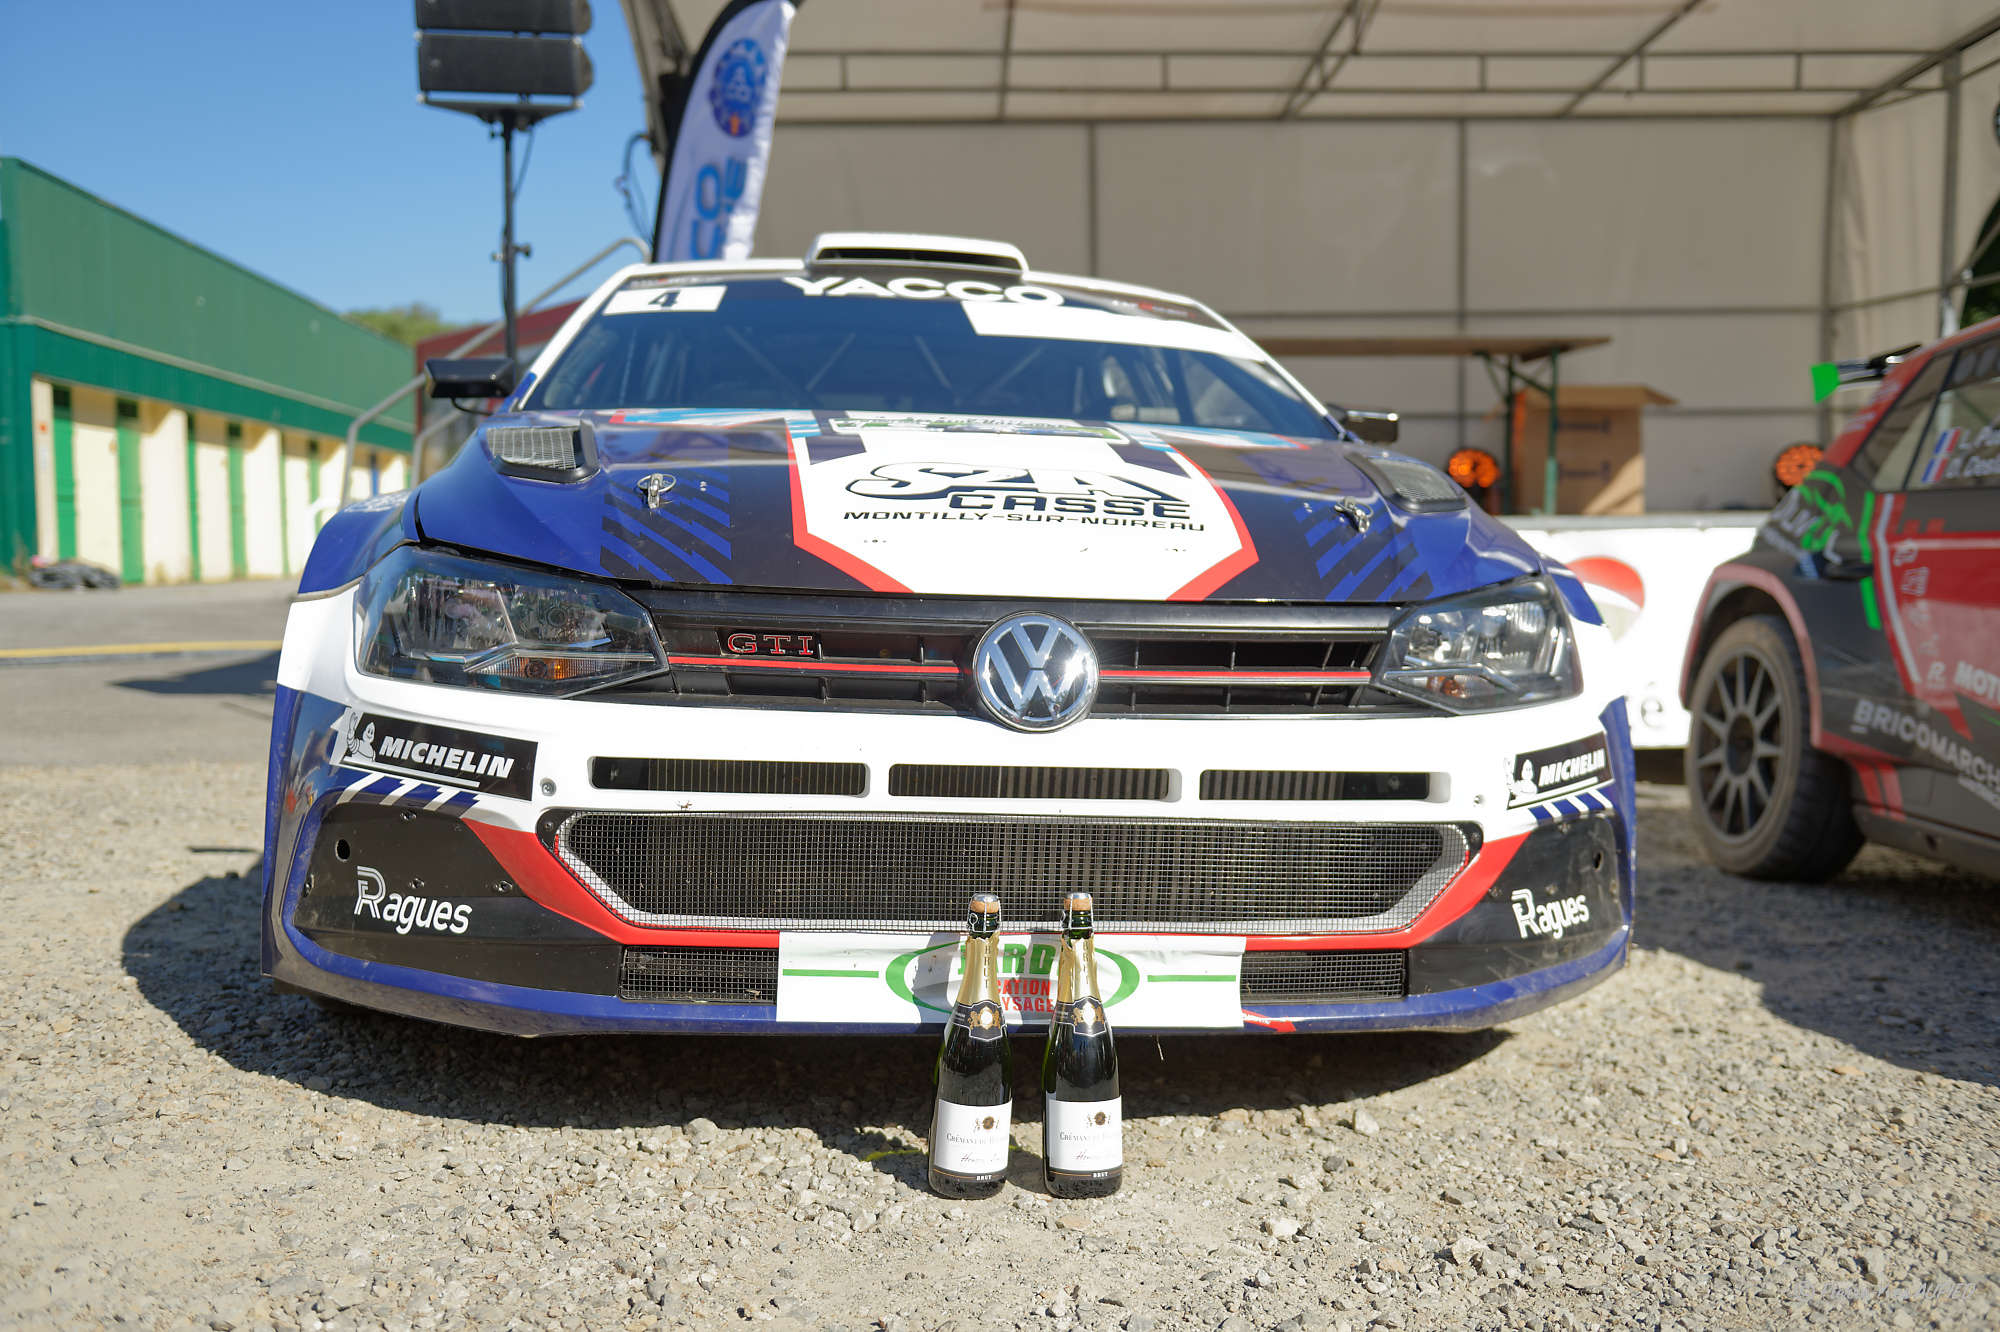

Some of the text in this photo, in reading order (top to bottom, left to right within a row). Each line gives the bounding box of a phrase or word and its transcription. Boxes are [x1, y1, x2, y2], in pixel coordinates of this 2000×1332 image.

[648, 290, 681, 309] 4
[782, 276, 1066, 307] YACCO
[843, 511, 1205, 531] MONTILLY-SUR-NOIREAU
[950, 493, 1190, 520] CASSE
[727, 633, 815, 655] GTI
[1954, 661, 2000, 706] MOT
[379, 735, 515, 779] MICHELIN
[1853, 699, 2000, 794] BRICOMARCH
[1538, 748, 1606, 787] MICHELIN
[354, 866, 472, 935] Ragues
[1511, 888, 1589, 939] Ragues
[1002, 996, 1055, 1013] YSAGE
